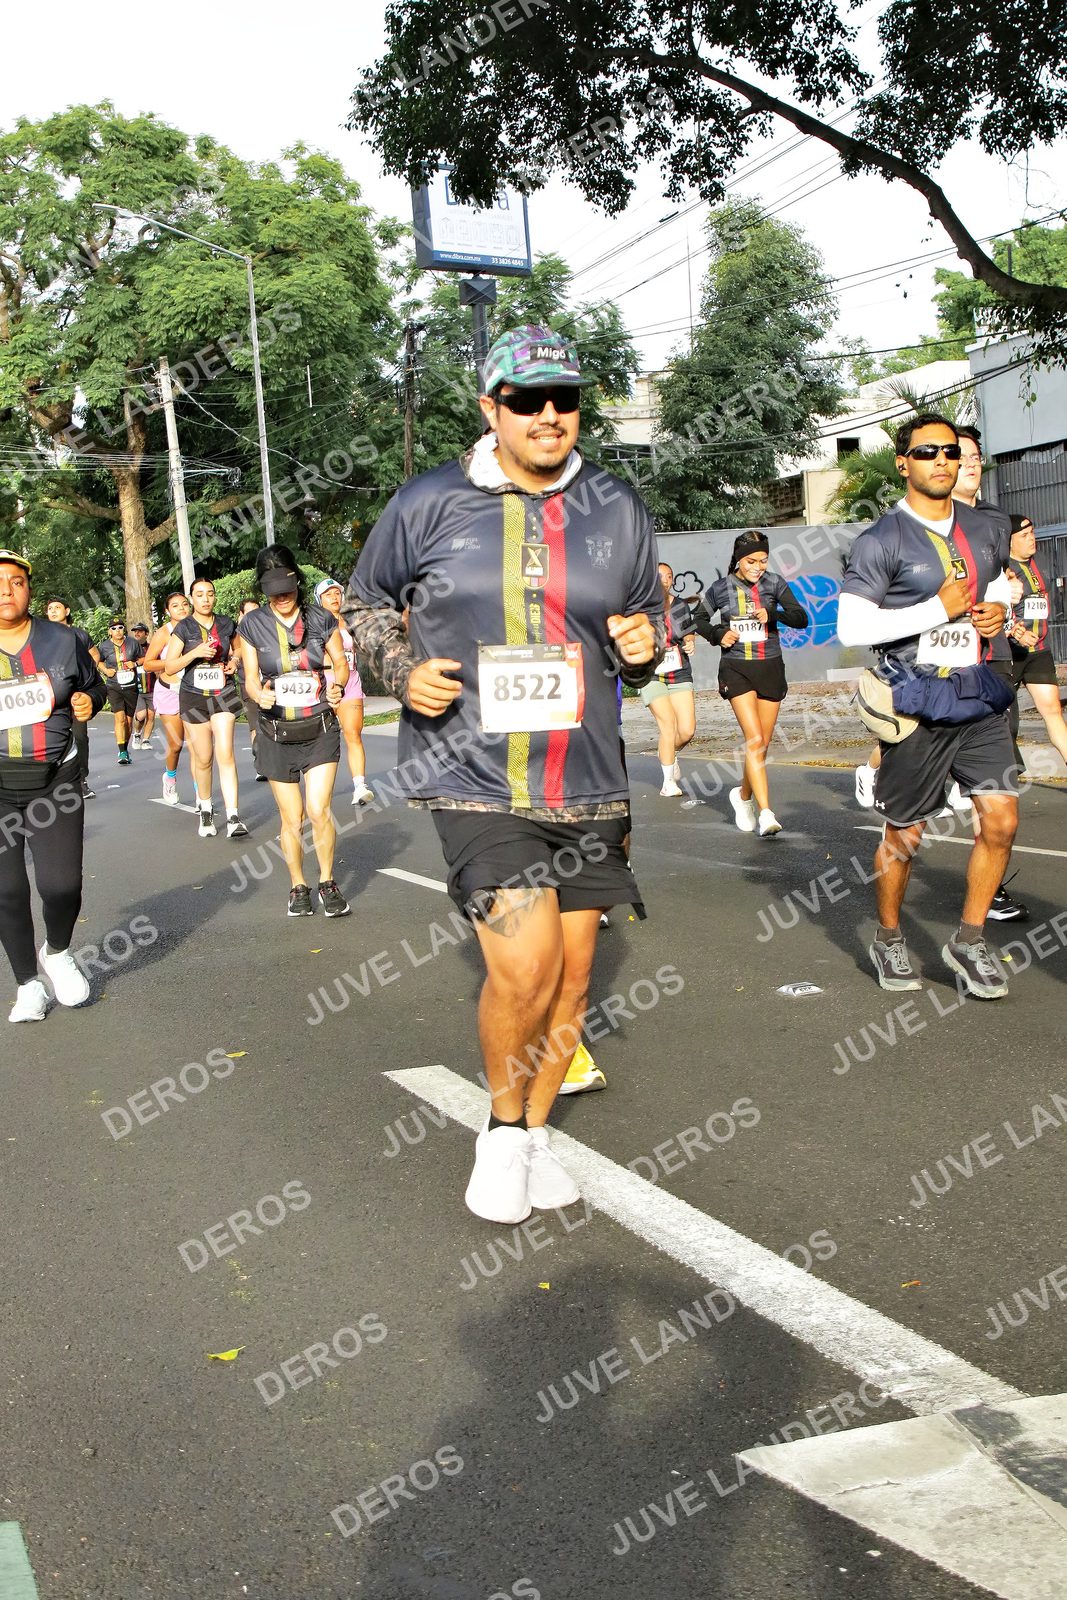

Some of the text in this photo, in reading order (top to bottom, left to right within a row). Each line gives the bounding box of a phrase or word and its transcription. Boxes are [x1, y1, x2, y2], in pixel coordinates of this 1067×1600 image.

[929, 630, 970, 648] 9095
[198, 671, 219, 681] 9560
[282, 682, 312, 695] 9432
[493, 673, 562, 702] 8522
